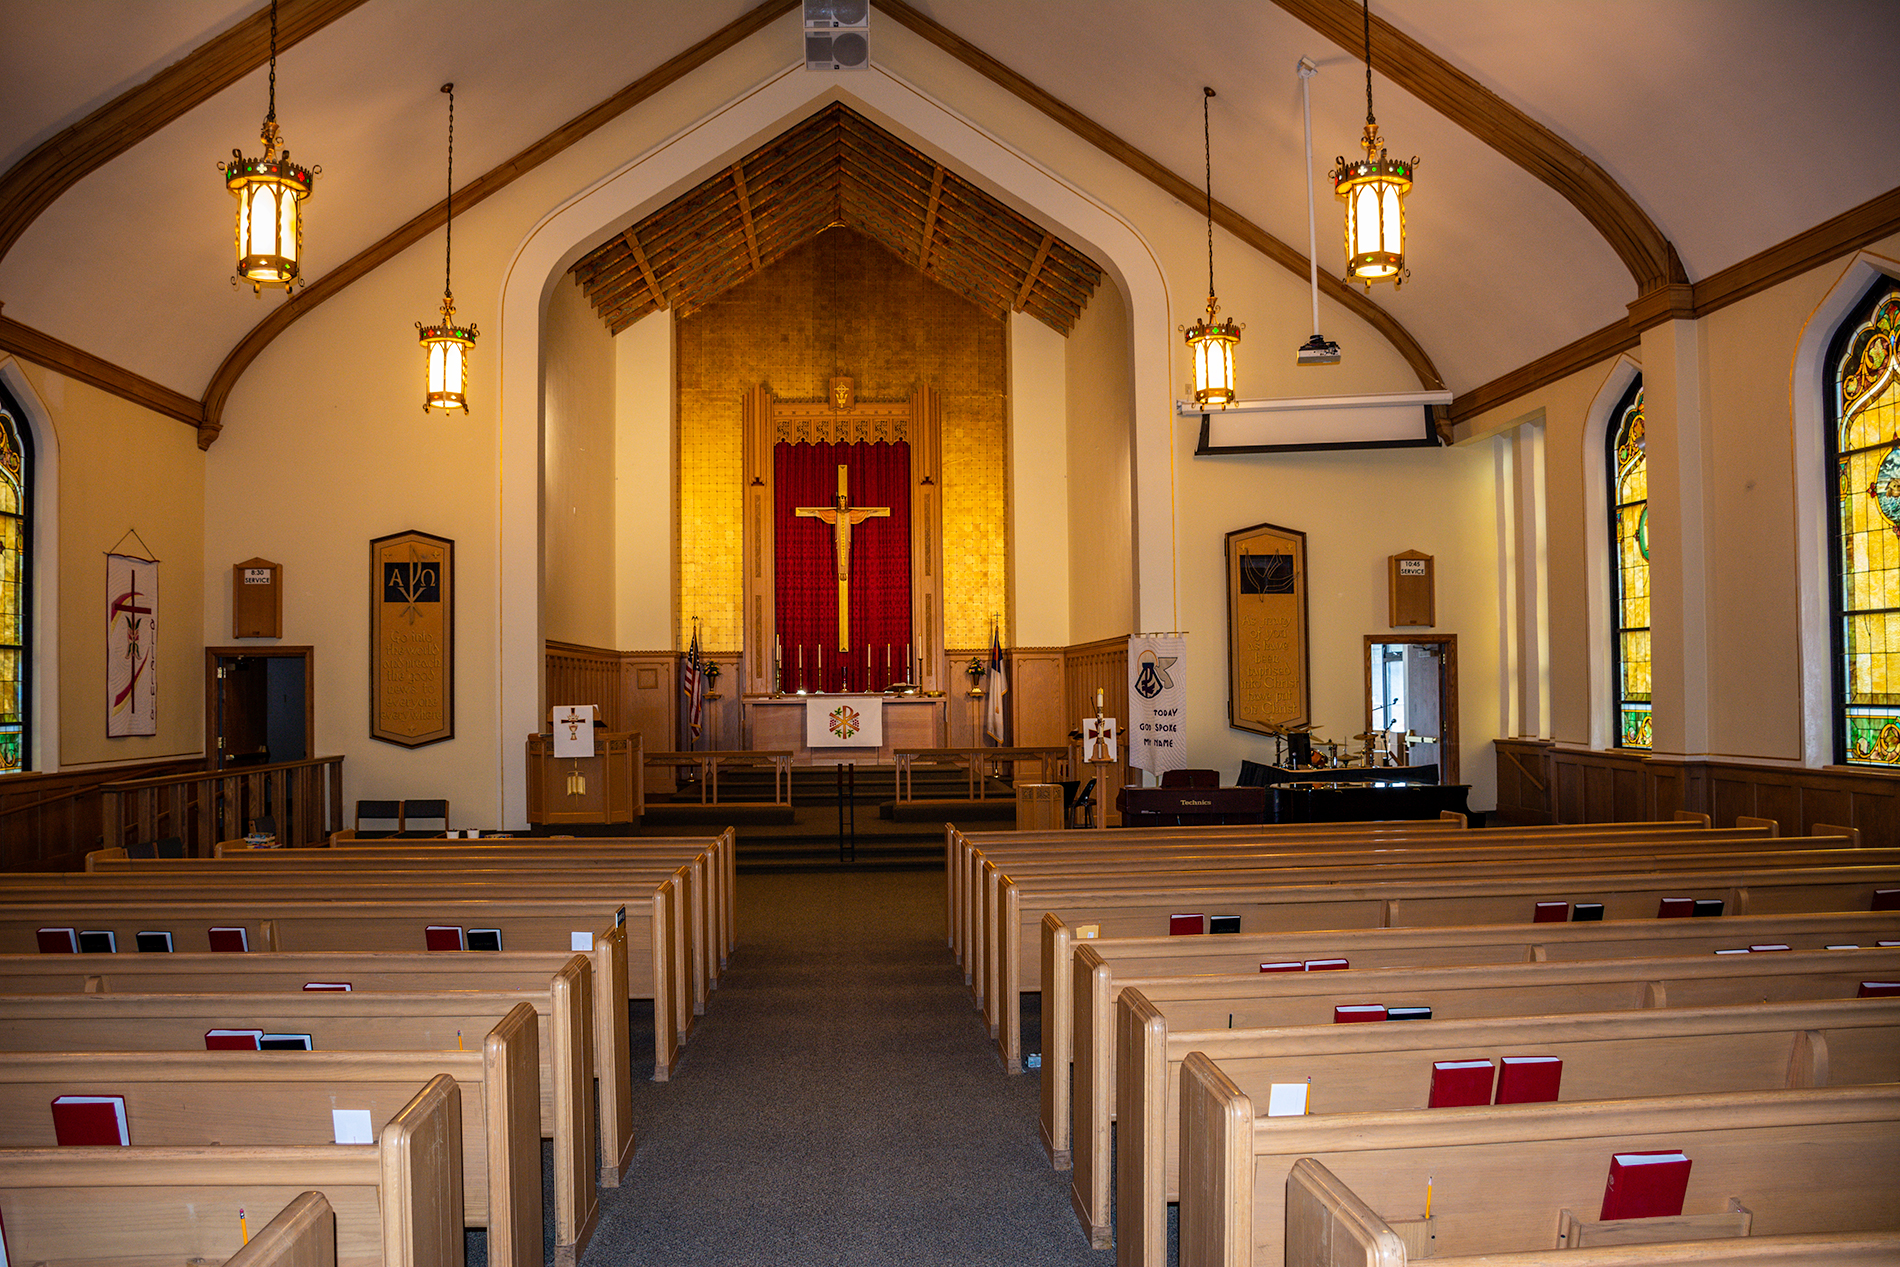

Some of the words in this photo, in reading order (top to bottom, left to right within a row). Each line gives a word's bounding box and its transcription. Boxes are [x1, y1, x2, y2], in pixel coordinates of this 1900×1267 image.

[420, 568, 436, 587] Ω
[1242, 615, 1256, 625] As
[1262, 617, 1291, 627] many
[390, 630, 408, 644] Go
[411, 630, 434, 643] into
[1250, 626, 1263, 641] of
[1265, 629, 1287, 641] you
[385, 643, 404, 656] the
[406, 643, 440, 656] world
[1247, 642, 1260, 651] as
[1263, 640, 1289, 651] have
[383, 656, 404, 669] and
[405, 655, 441, 672] preach
[1254, 652, 1280, 664] been
[387, 670, 404, 682] the
[408, 669, 435, 684] good
[1247, 664, 1291, 679] baptised
[387, 685, 417, 695] news
[422, 682, 435, 694] to
[1240, 677, 1262, 689] into
[1263, 675, 1300, 689] Christ
[1247, 690, 1271, 702] have
[1275, 689, 1293, 703] put
[385, 698, 438, 710] everyone
[1243, 704, 1258, 715] on
[1261, 701, 1298, 715] Christ
[1139, 722, 1151, 731] GOD
[1155, 723, 1177, 732] SPOKE
[1154, 739, 1173, 747] NAME
